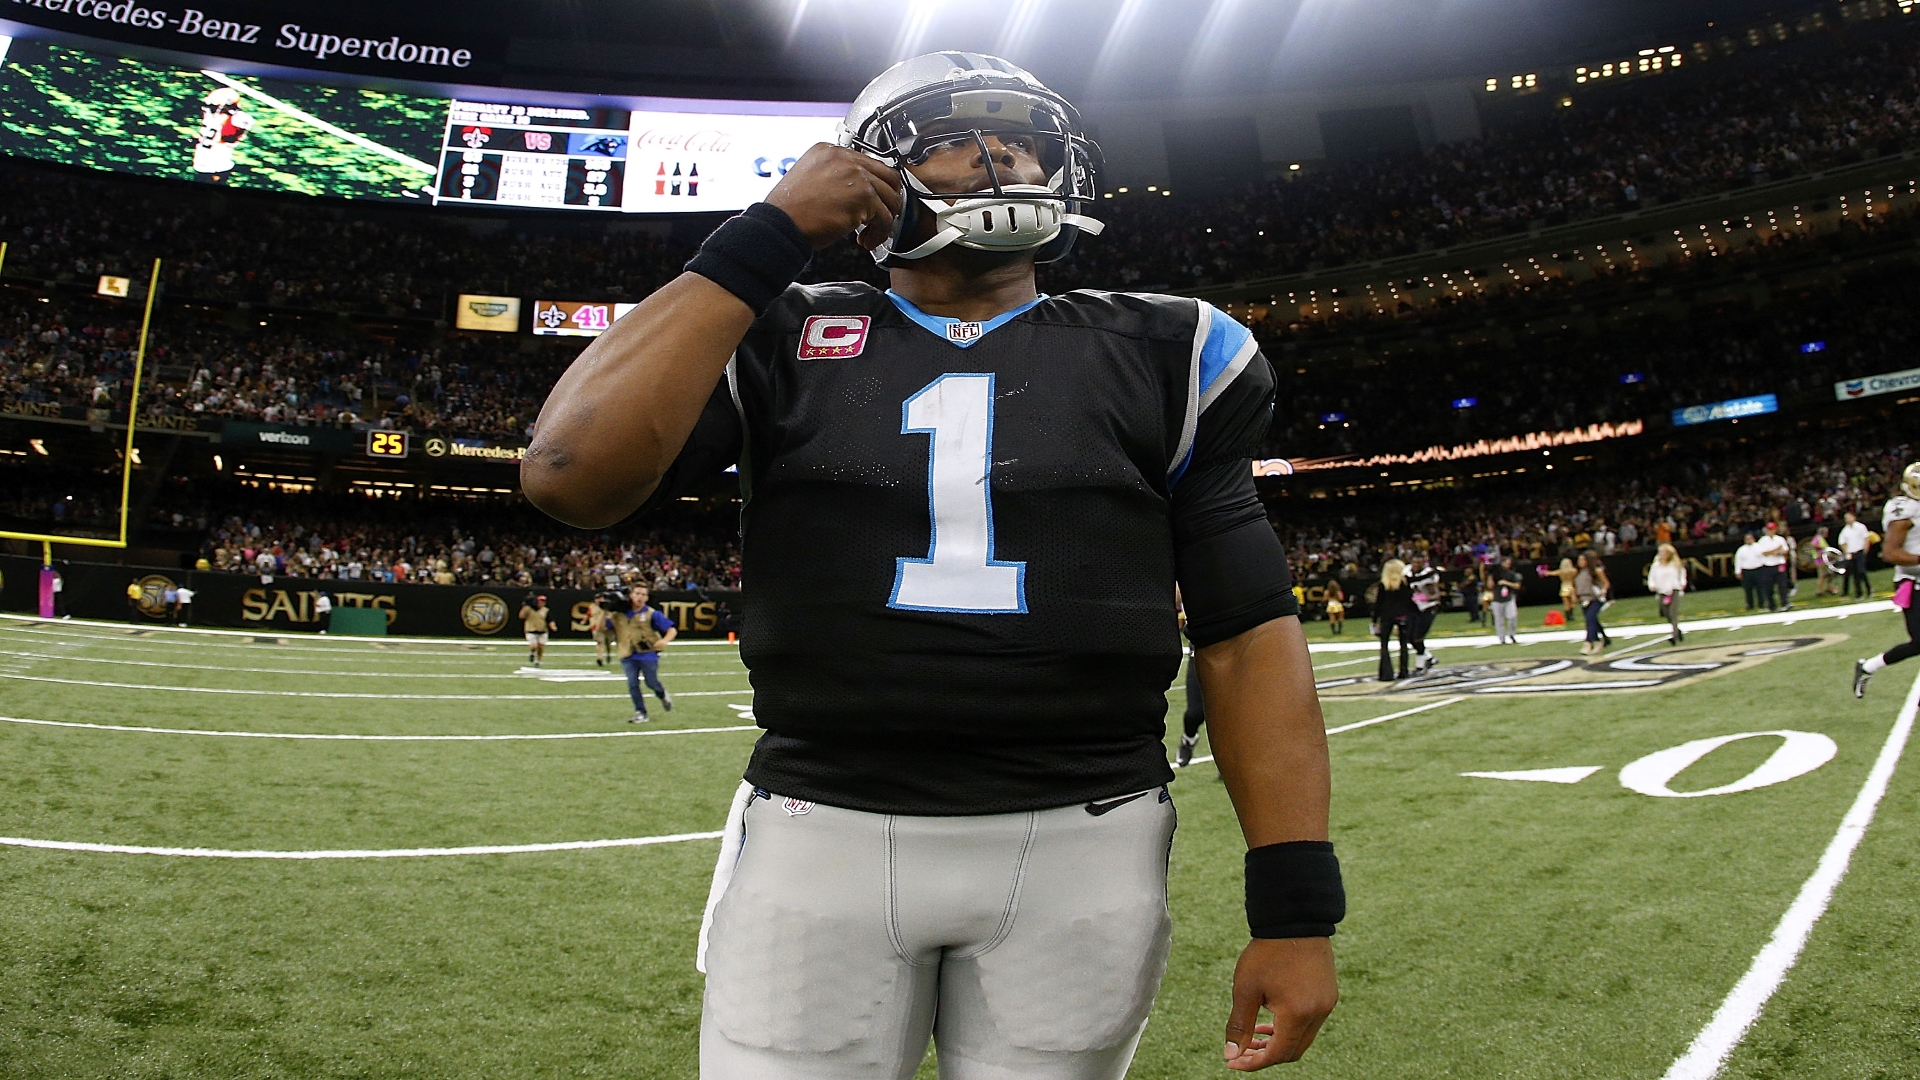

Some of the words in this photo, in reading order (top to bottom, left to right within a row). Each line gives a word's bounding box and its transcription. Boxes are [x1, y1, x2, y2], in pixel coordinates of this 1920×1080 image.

[12, 0, 260, 44] ercedes-Benz
[276, 23, 472, 68] Superdome
[525, 132, 552, 151] VS
[572, 305, 609, 329] 41
[806, 318, 864, 347] C
[952, 327, 977, 339] NFL
[2, 401, 62, 418] SAINTS
[136, 413, 198, 431] SAINTS
[259, 431, 310, 446] verizon
[372, 433, 403, 455] 25
[886, 372, 1029, 615] 1
